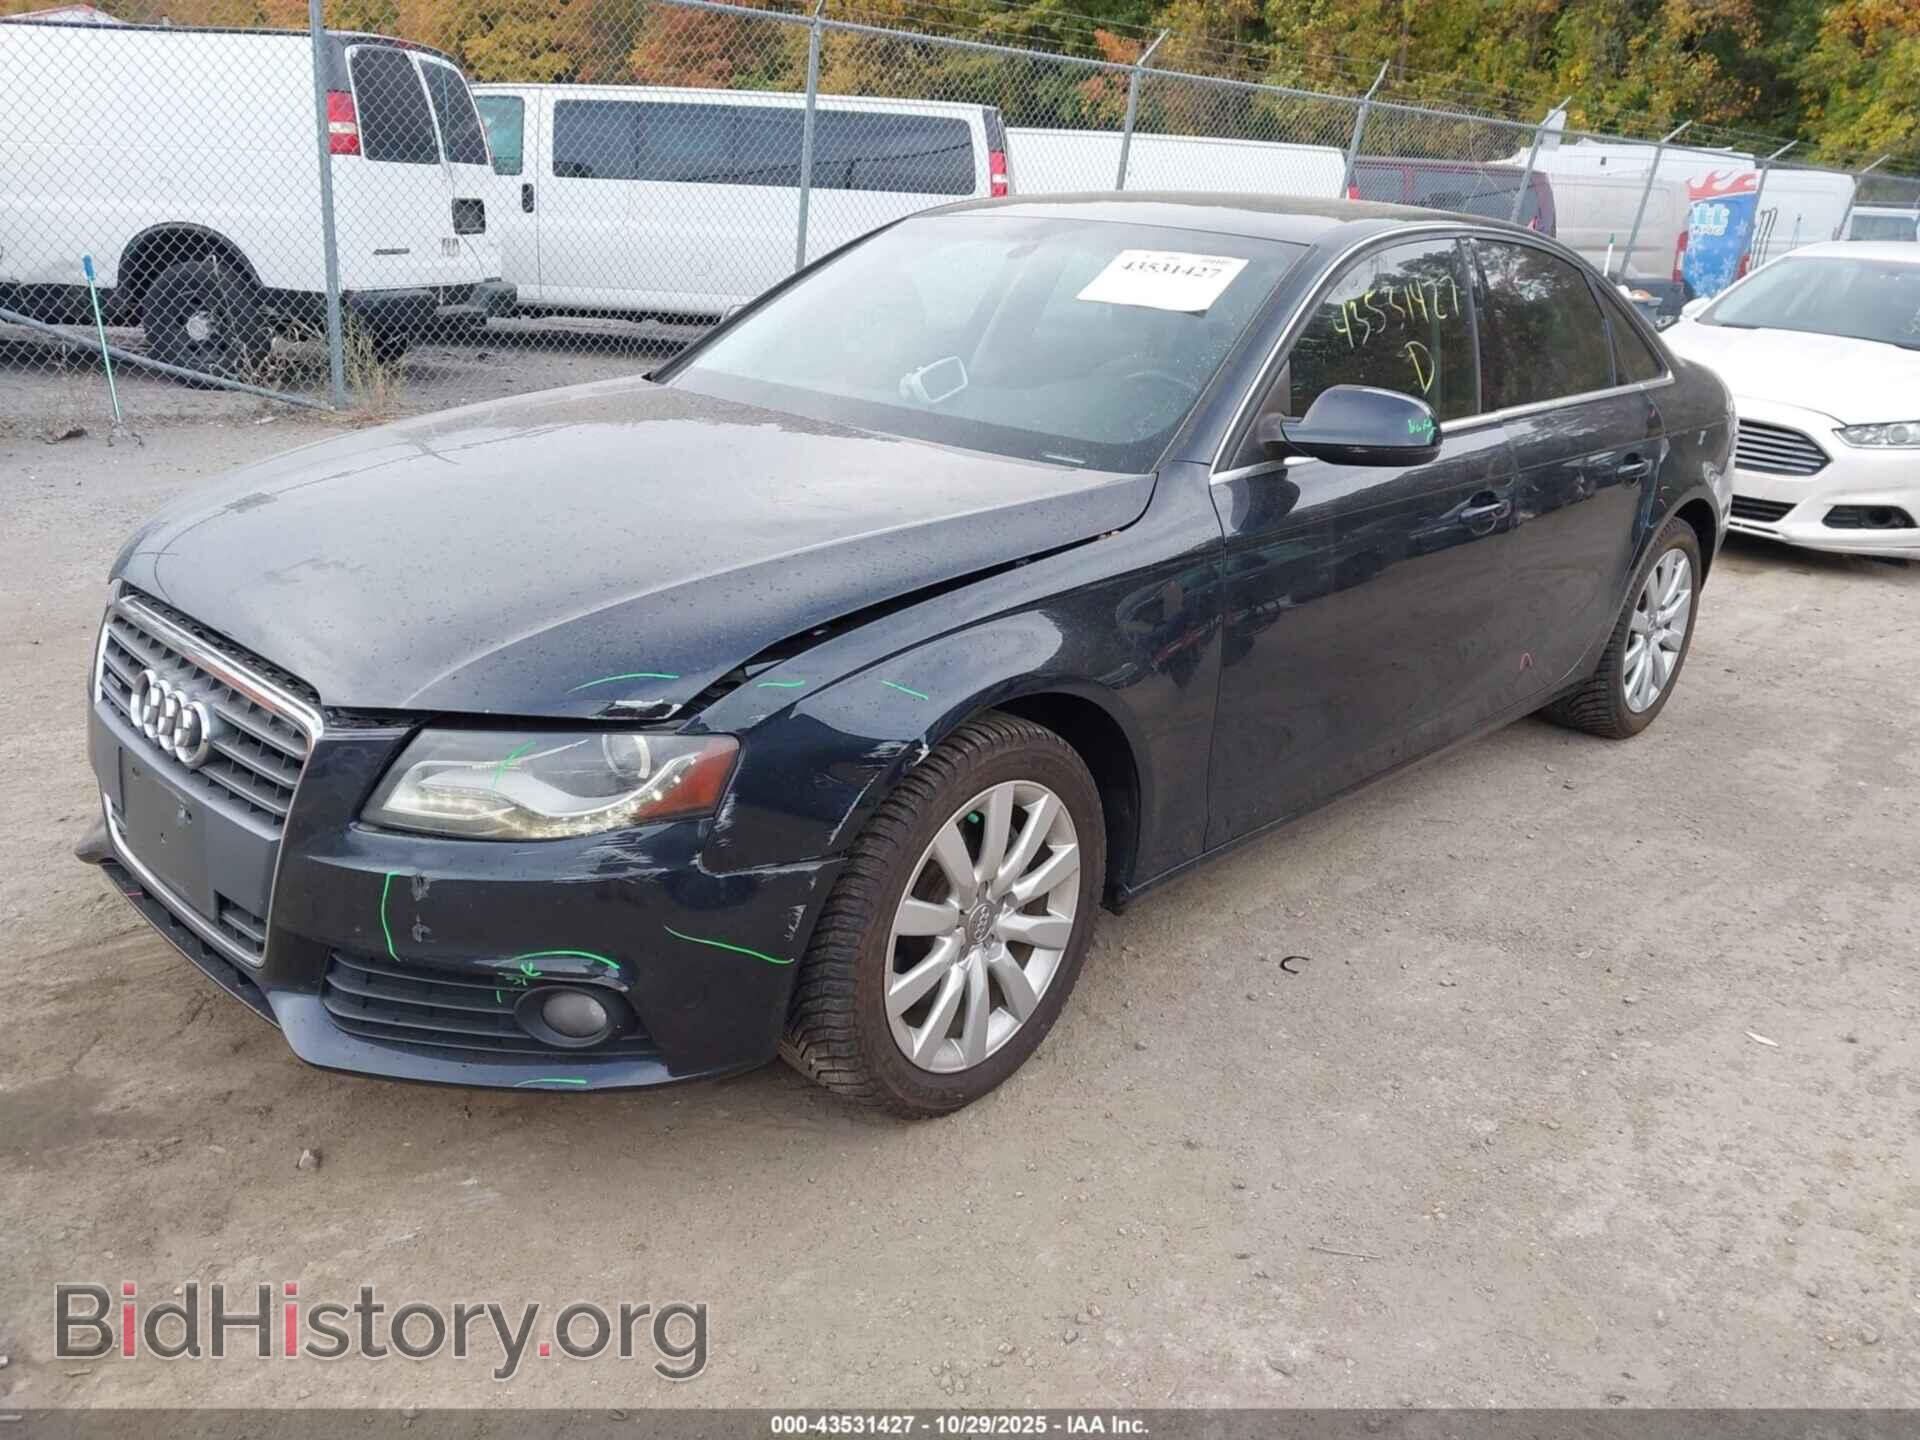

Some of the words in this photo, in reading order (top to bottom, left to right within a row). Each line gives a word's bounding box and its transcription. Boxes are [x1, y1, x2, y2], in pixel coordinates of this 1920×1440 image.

[1121, 259, 1223, 279] 43531427
[1332, 275, 1460, 348] 43531427
[1404, 340, 1436, 394] D
